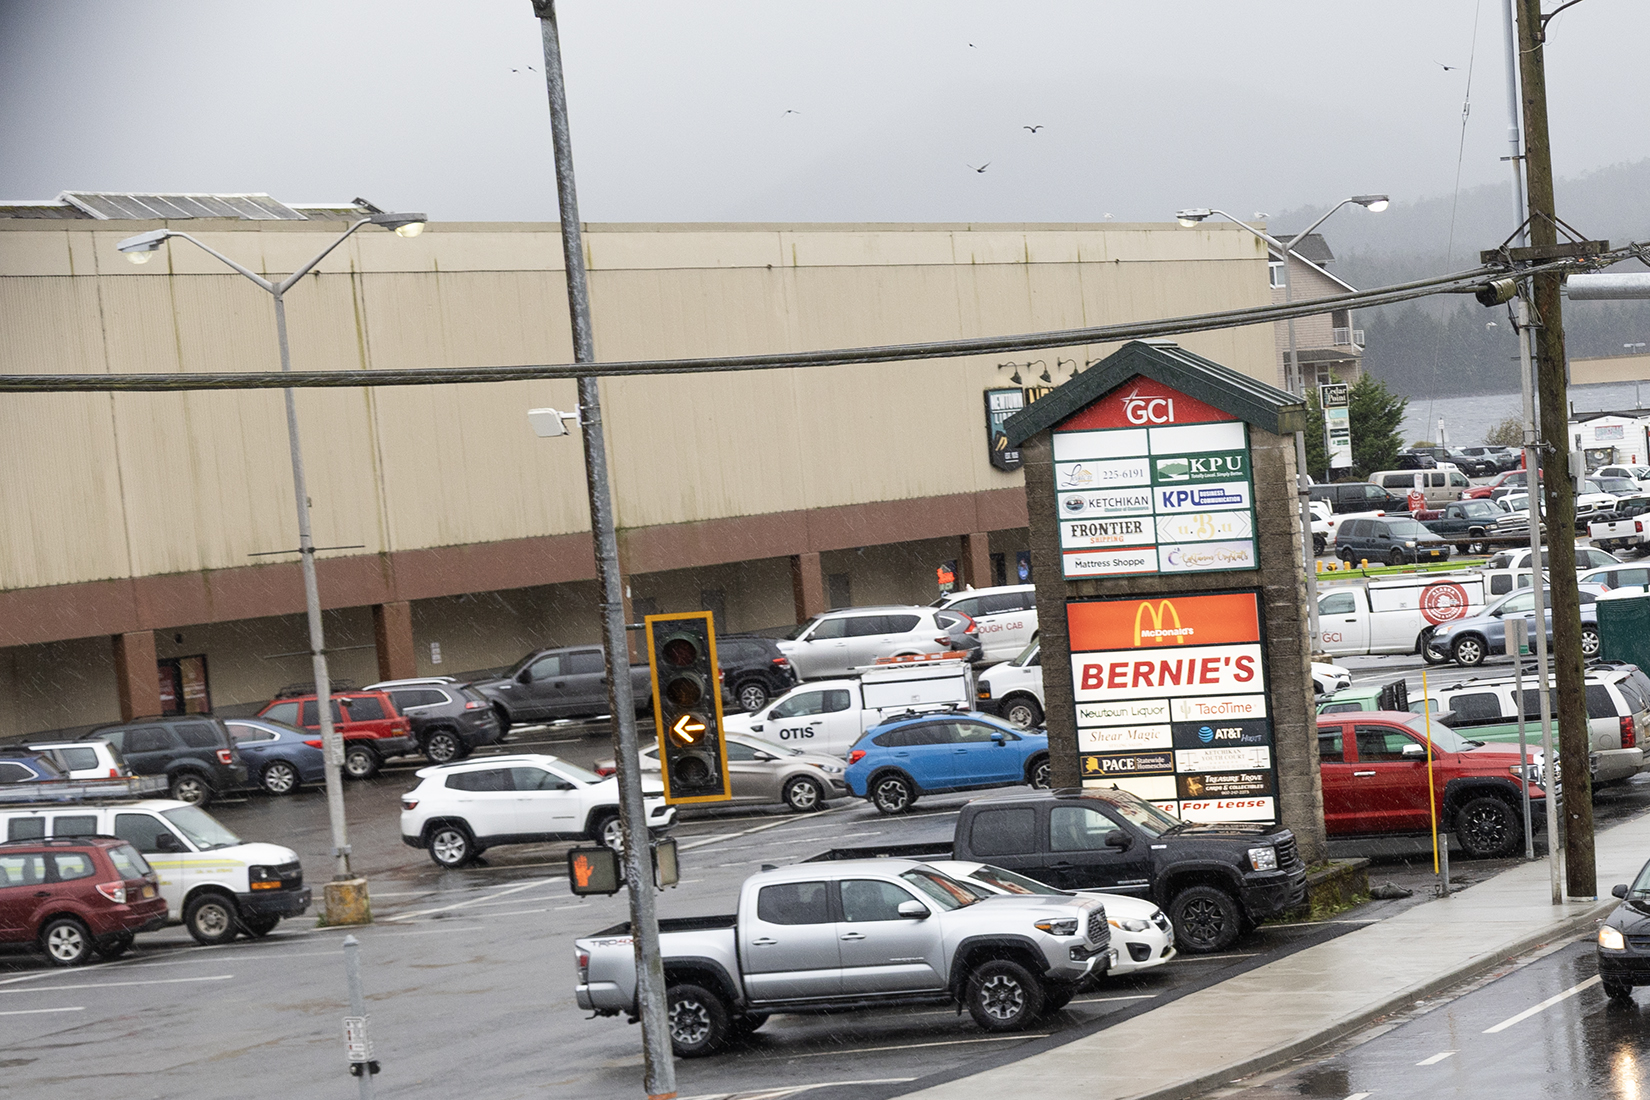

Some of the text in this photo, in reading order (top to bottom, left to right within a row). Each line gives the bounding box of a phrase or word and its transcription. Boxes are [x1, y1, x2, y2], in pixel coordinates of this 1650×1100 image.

[1325, 387, 1346, 395] Cedar
[1328, 394, 1346, 402] Point
[1126, 398, 1174, 425] GCI
[1189, 455, 1242, 473] KPU
[1103, 468, 1144, 480] 225-6191
[1088, 496, 1149, 508] KETCHIKAN
[1162, 490, 1200, 508] KPU
[1070, 521, 1143, 537] FRONTIER
[1090, 535, 1124, 544] SHIPPING
[1075, 558, 1145, 568] Mattress Shoppe
[1432, 587, 1455, 596] ALASKA
[978, 621, 1024, 634] OUGH CAB
[1141, 628, 1194, 638] McDonald's
[1322, 632, 1343, 643] GCI
[1080, 655, 1255, 691] BERNIE'S
[1080, 706, 1165, 719] Newtown Liquor
[1195, 702, 1253, 714] TacoTime
[780, 726, 815, 740] OTIS
[1090, 728, 1161, 742] Shear Magic
[1215, 727, 1243, 739] AT&T
[1102, 758, 1135, 771] PACE
[1204, 773, 1263, 783] TREASURE TROVE
[1182, 802, 1210, 810] For
[1217, 800, 1266, 809] Lease
